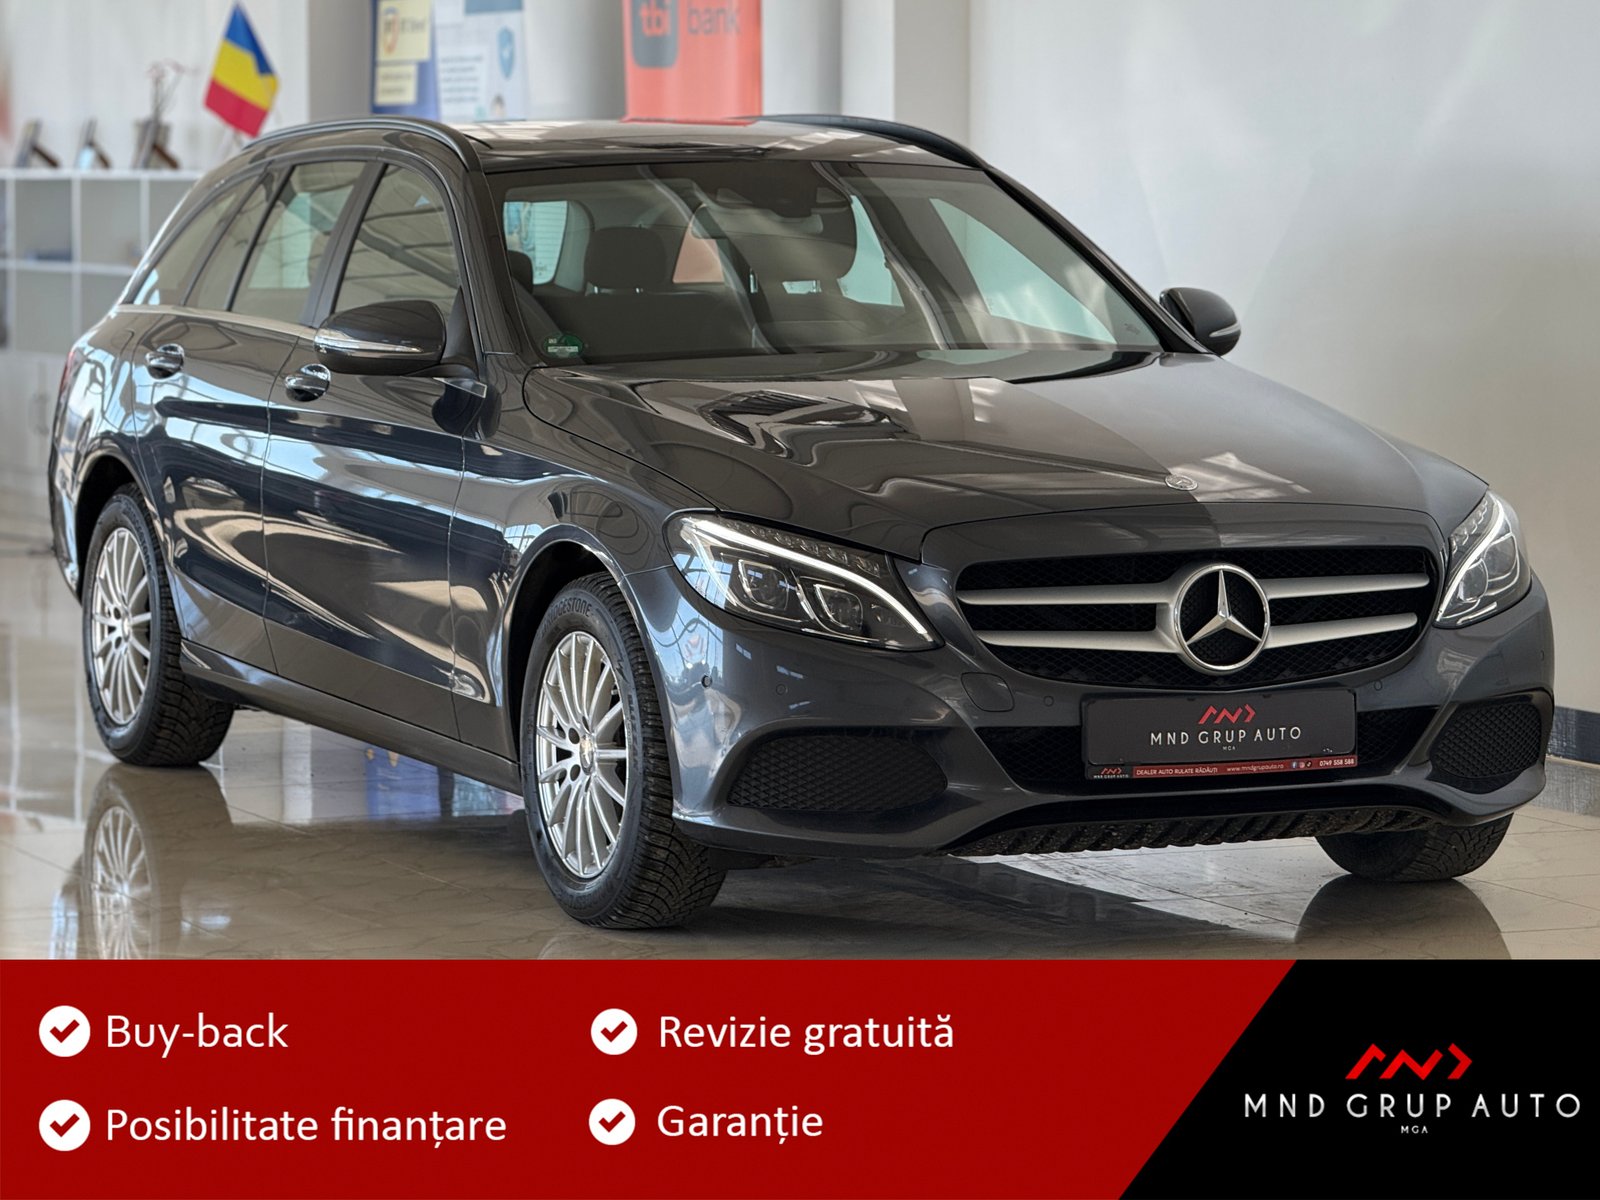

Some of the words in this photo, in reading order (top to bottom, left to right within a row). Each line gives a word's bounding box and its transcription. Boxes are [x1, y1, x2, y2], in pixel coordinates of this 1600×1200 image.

[687, 0, 740, 35] bank
[1150, 732, 1189, 745] MND
[1198, 729, 1247, 744] GRUP
[1254, 726, 1301, 741] AUTO
[1136, 768, 1157, 776] DEALER
